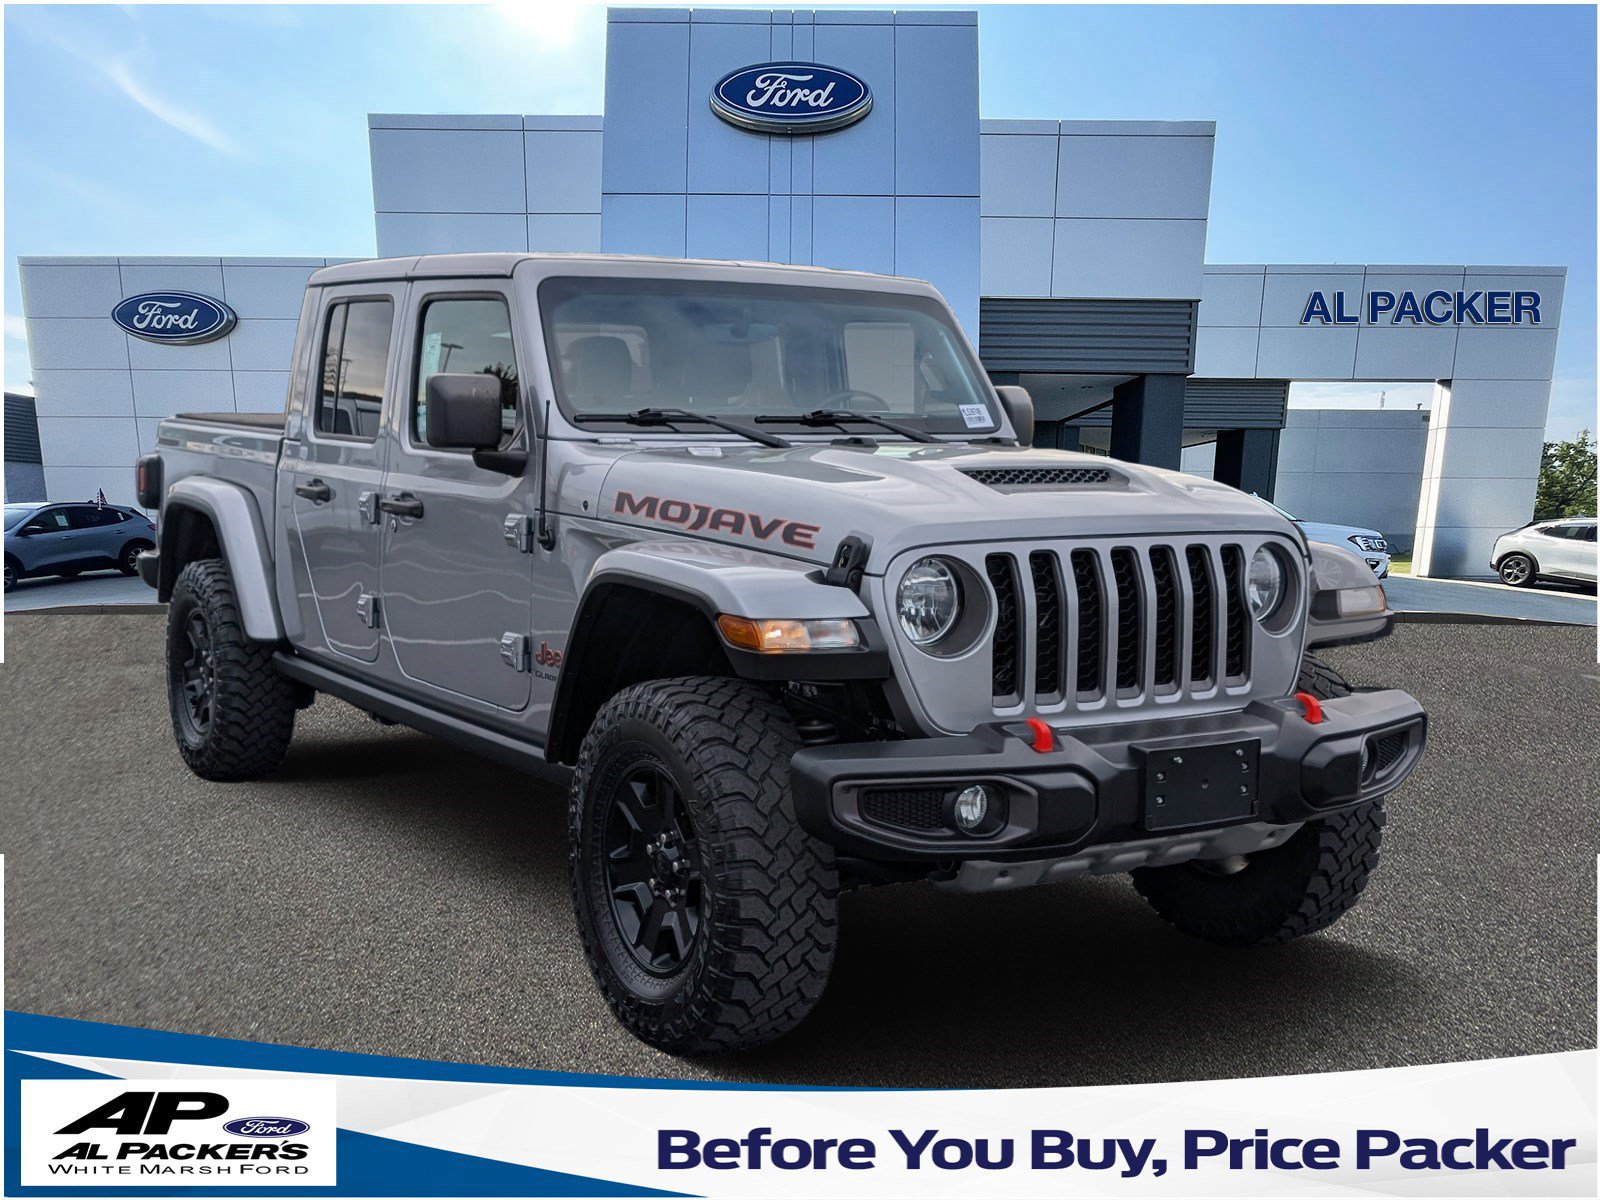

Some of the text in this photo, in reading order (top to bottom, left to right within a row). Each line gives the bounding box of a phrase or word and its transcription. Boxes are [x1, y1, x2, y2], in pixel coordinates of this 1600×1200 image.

[746, 73, 836, 107] Ford
[133, 301, 198, 329] Ford
[1302, 290, 1542, 324] AL PACKER
[614, 490, 822, 549] MOJAVE
[535, 641, 562, 668] Jee
[535, 670, 557, 682] GLADI
